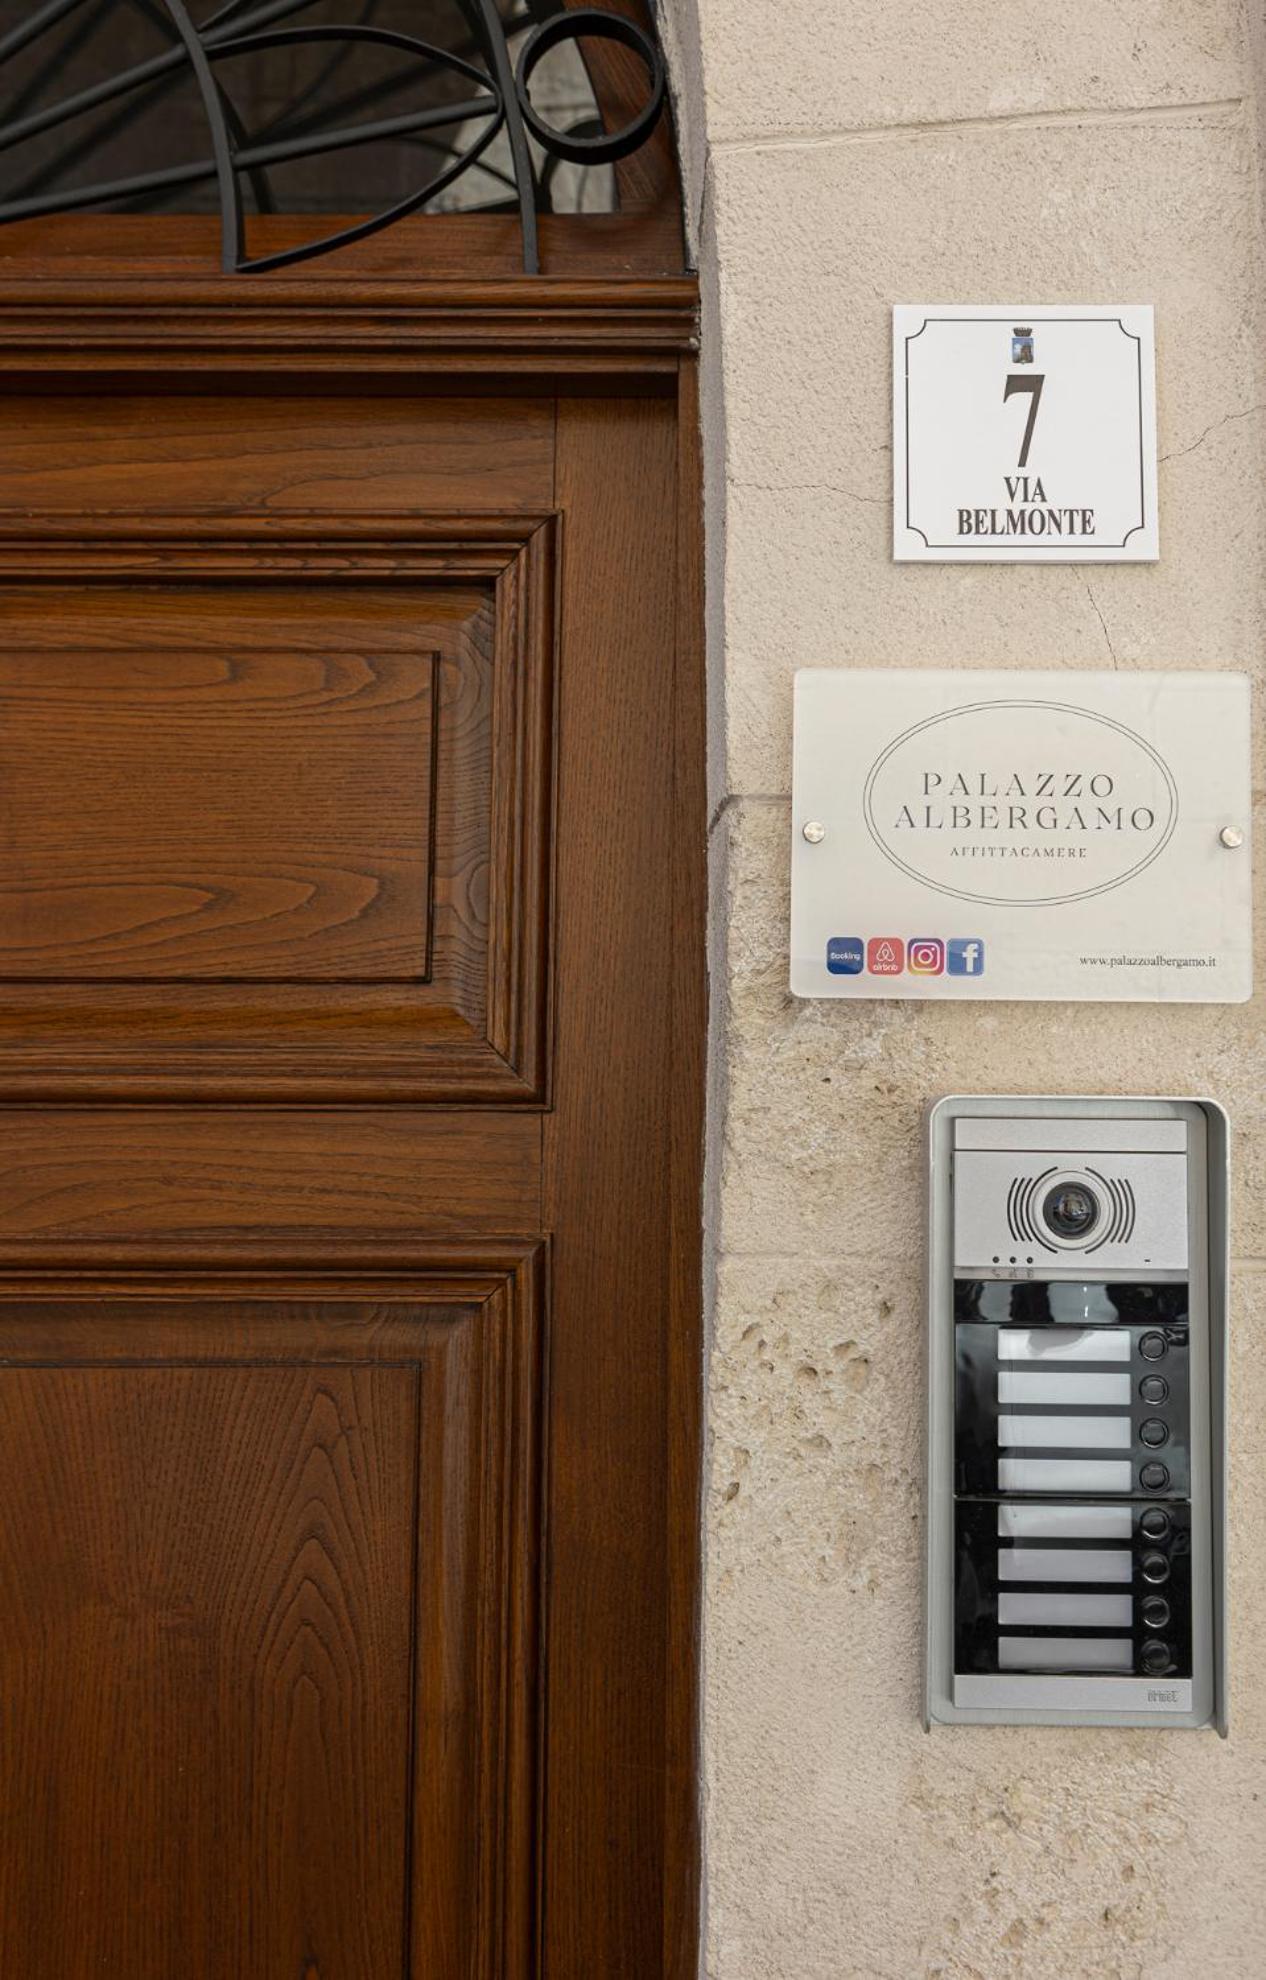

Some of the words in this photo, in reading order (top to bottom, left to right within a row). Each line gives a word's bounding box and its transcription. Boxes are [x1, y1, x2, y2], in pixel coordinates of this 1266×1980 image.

[1003, 374, 1046, 468] 7
[1003, 476, 1048, 503] VIA
[957, 509, 1096, 535] BELMONTE
[922, 772, 1114, 798] PALAZZO
[894, 805, 1155, 831] ALBERGAMO
[950, 846, 1087, 858] AFFITTACAMERE
[1079, 955, 1216, 968] www.palazzoalbergamo.it
